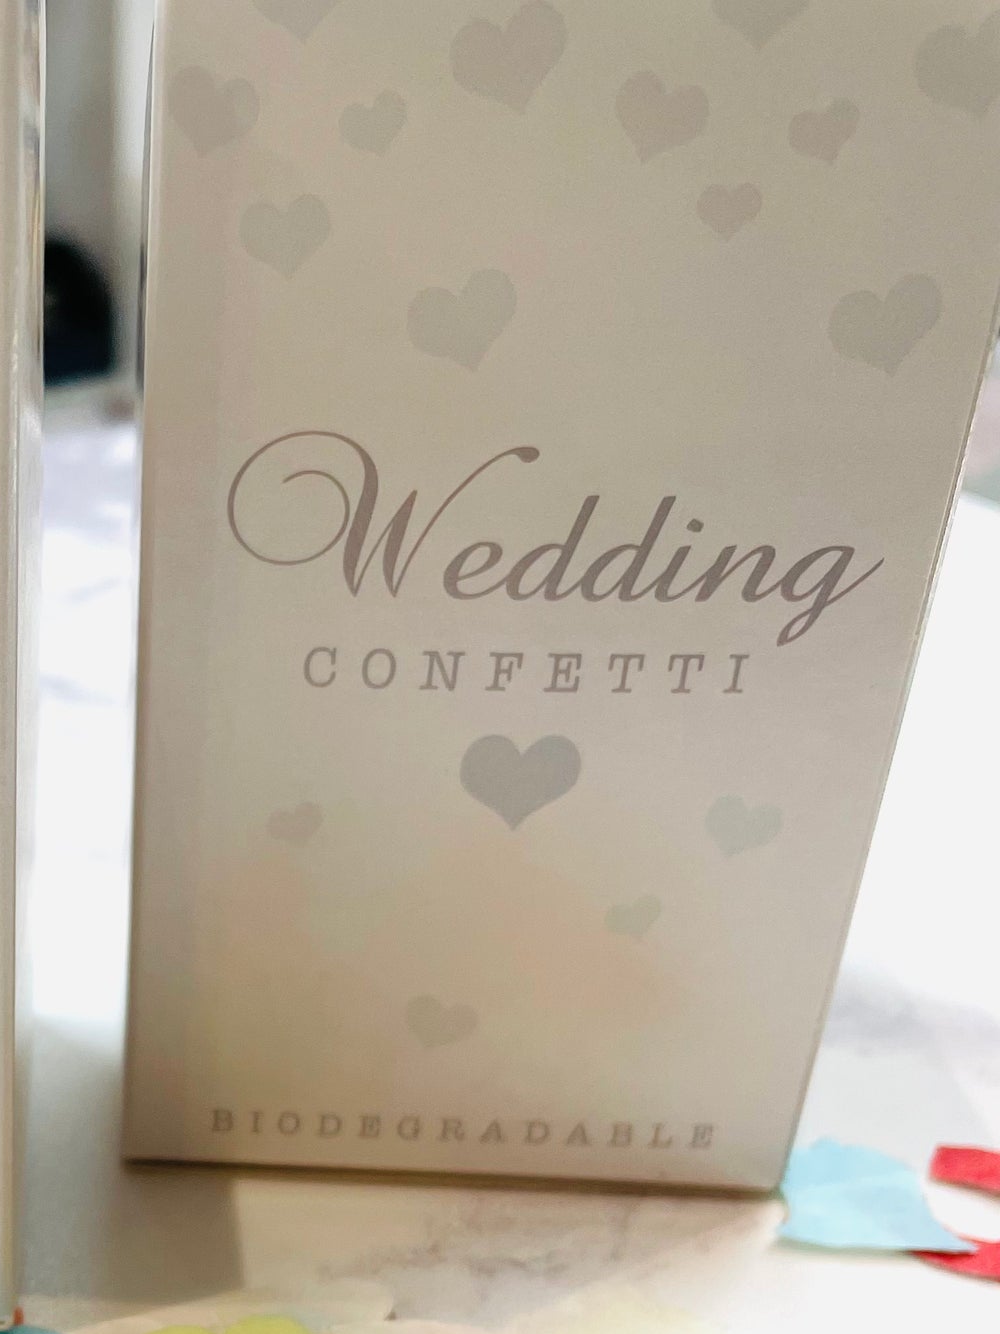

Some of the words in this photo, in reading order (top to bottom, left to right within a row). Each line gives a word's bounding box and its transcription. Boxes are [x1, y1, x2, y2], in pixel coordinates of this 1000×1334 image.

[227, 430, 885, 646] Wedding
[303, 647, 750, 694] CONFETTI
[211, 1108, 717, 1150] BIODEGRADABLE
